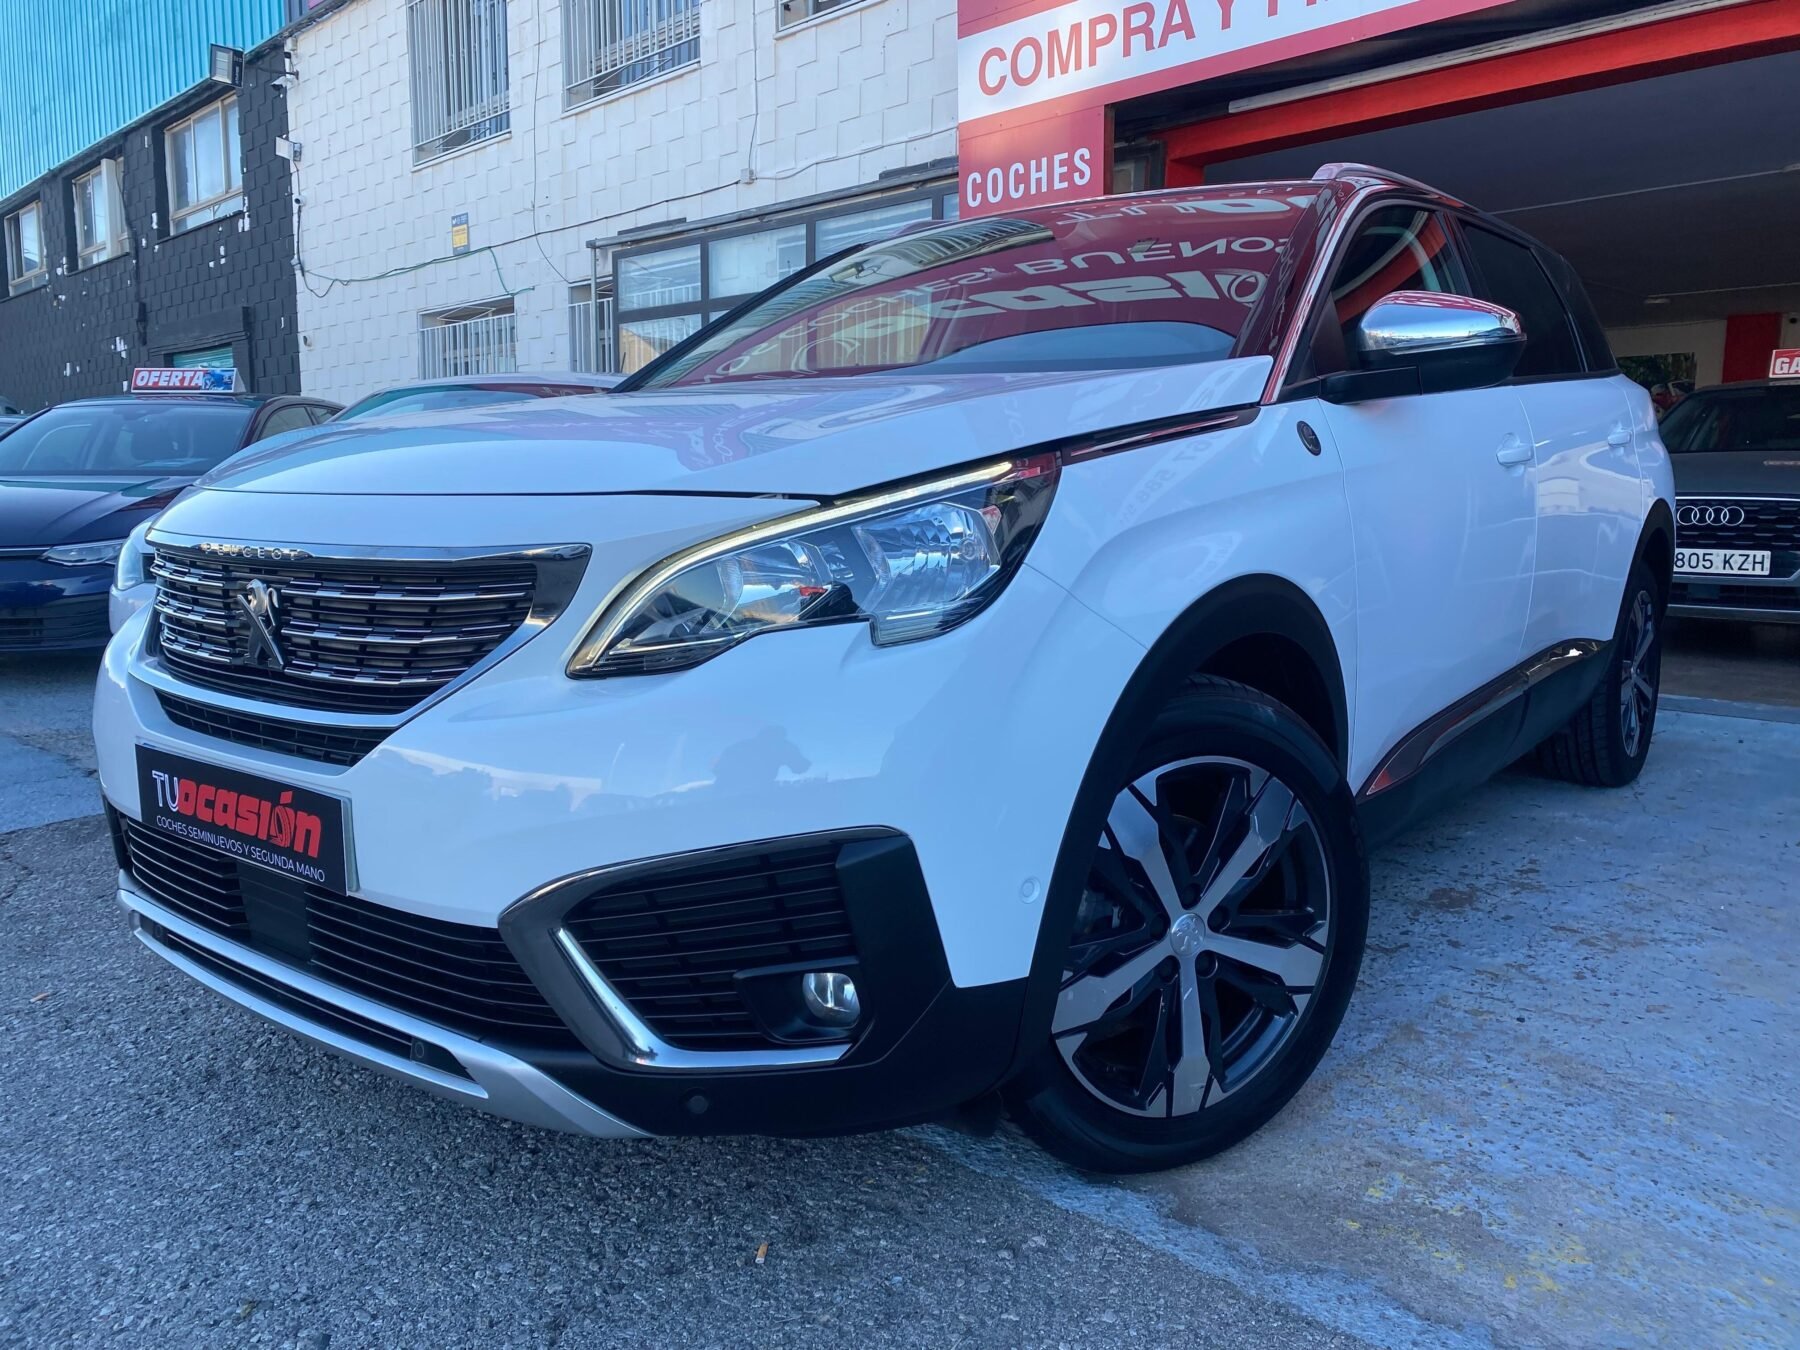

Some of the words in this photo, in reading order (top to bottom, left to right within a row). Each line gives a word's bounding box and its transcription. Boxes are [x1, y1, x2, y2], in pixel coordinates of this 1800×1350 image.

[978, 0, 1197, 97] COMPRA
[966, 147, 1092, 209] COCHES
[135, 370, 204, 387] OFERTA
[203, 543, 299, 561] PEUGEOT
[1674, 551, 1714, 570] 805
[1722, 553, 1766, 572] KZH
[156, 815, 188, 836] COCHES
[187, 825, 244, 855] SEMINUEVOS
[241, 841, 251, 856] Y
[249, 846, 296, 873] SEGUNDA
[295, 861, 326, 883] MANO
